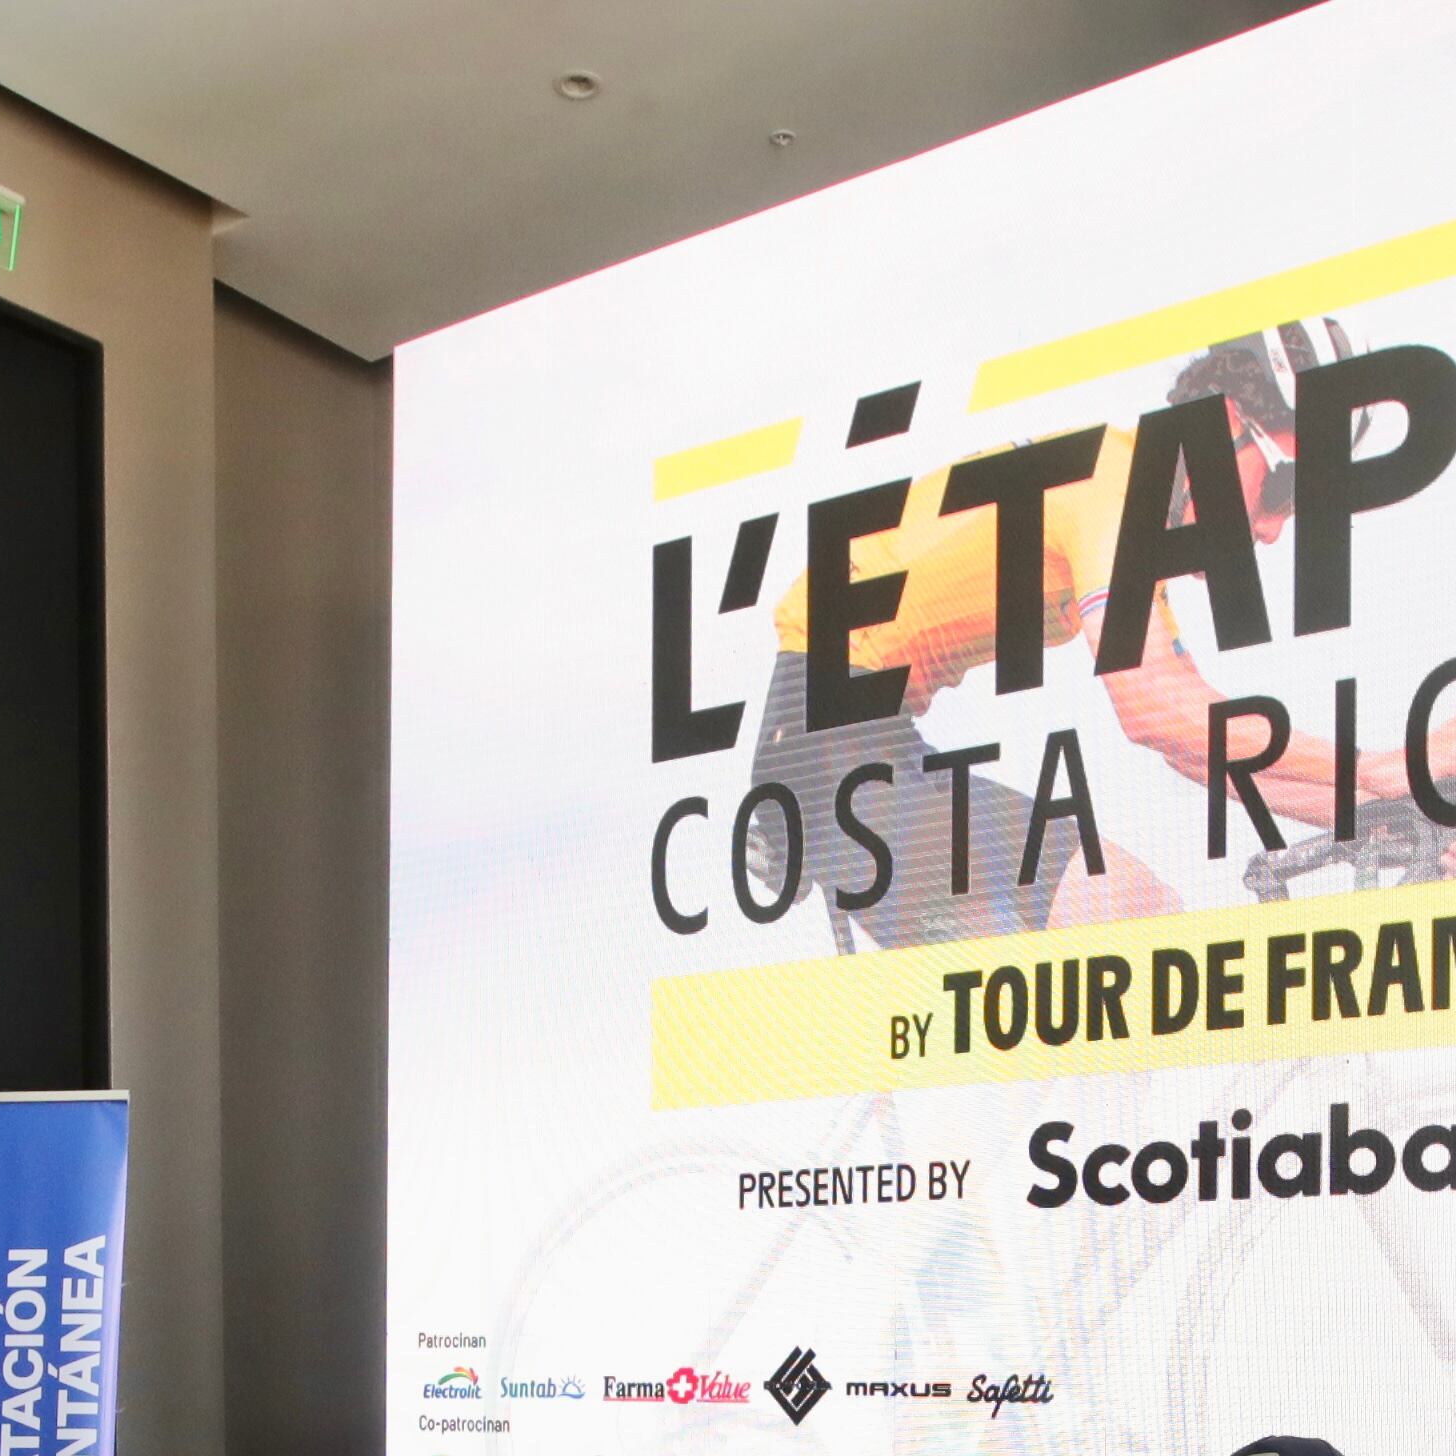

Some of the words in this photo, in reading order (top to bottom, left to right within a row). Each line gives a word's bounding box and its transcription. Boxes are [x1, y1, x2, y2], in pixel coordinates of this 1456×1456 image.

[651, 728, 1106, 934] COSTA
[890, 1012, 932, 1060] BY
[944, 953, 1130, 1055] TOUR
[1151, 940, 1244, 1037] DE
[738, 1165, 916, 1209] PRESENTED
[928, 1160, 971, 1201] BY
[418, 1332, 486, 1349] Patrocinan
[423, 1383, 482, 1400] Electrolit
[500, 1377, 557, 1399] Suntab
[603, 1376, 665, 1398] Farma
[699, 1371, 751, 1399] Value
[846, 1382, 952, 1398] MAXUS
[966, 1374, 1054, 1419] Safetti
[419, 1415, 510, 1434] Co-patrocinan
